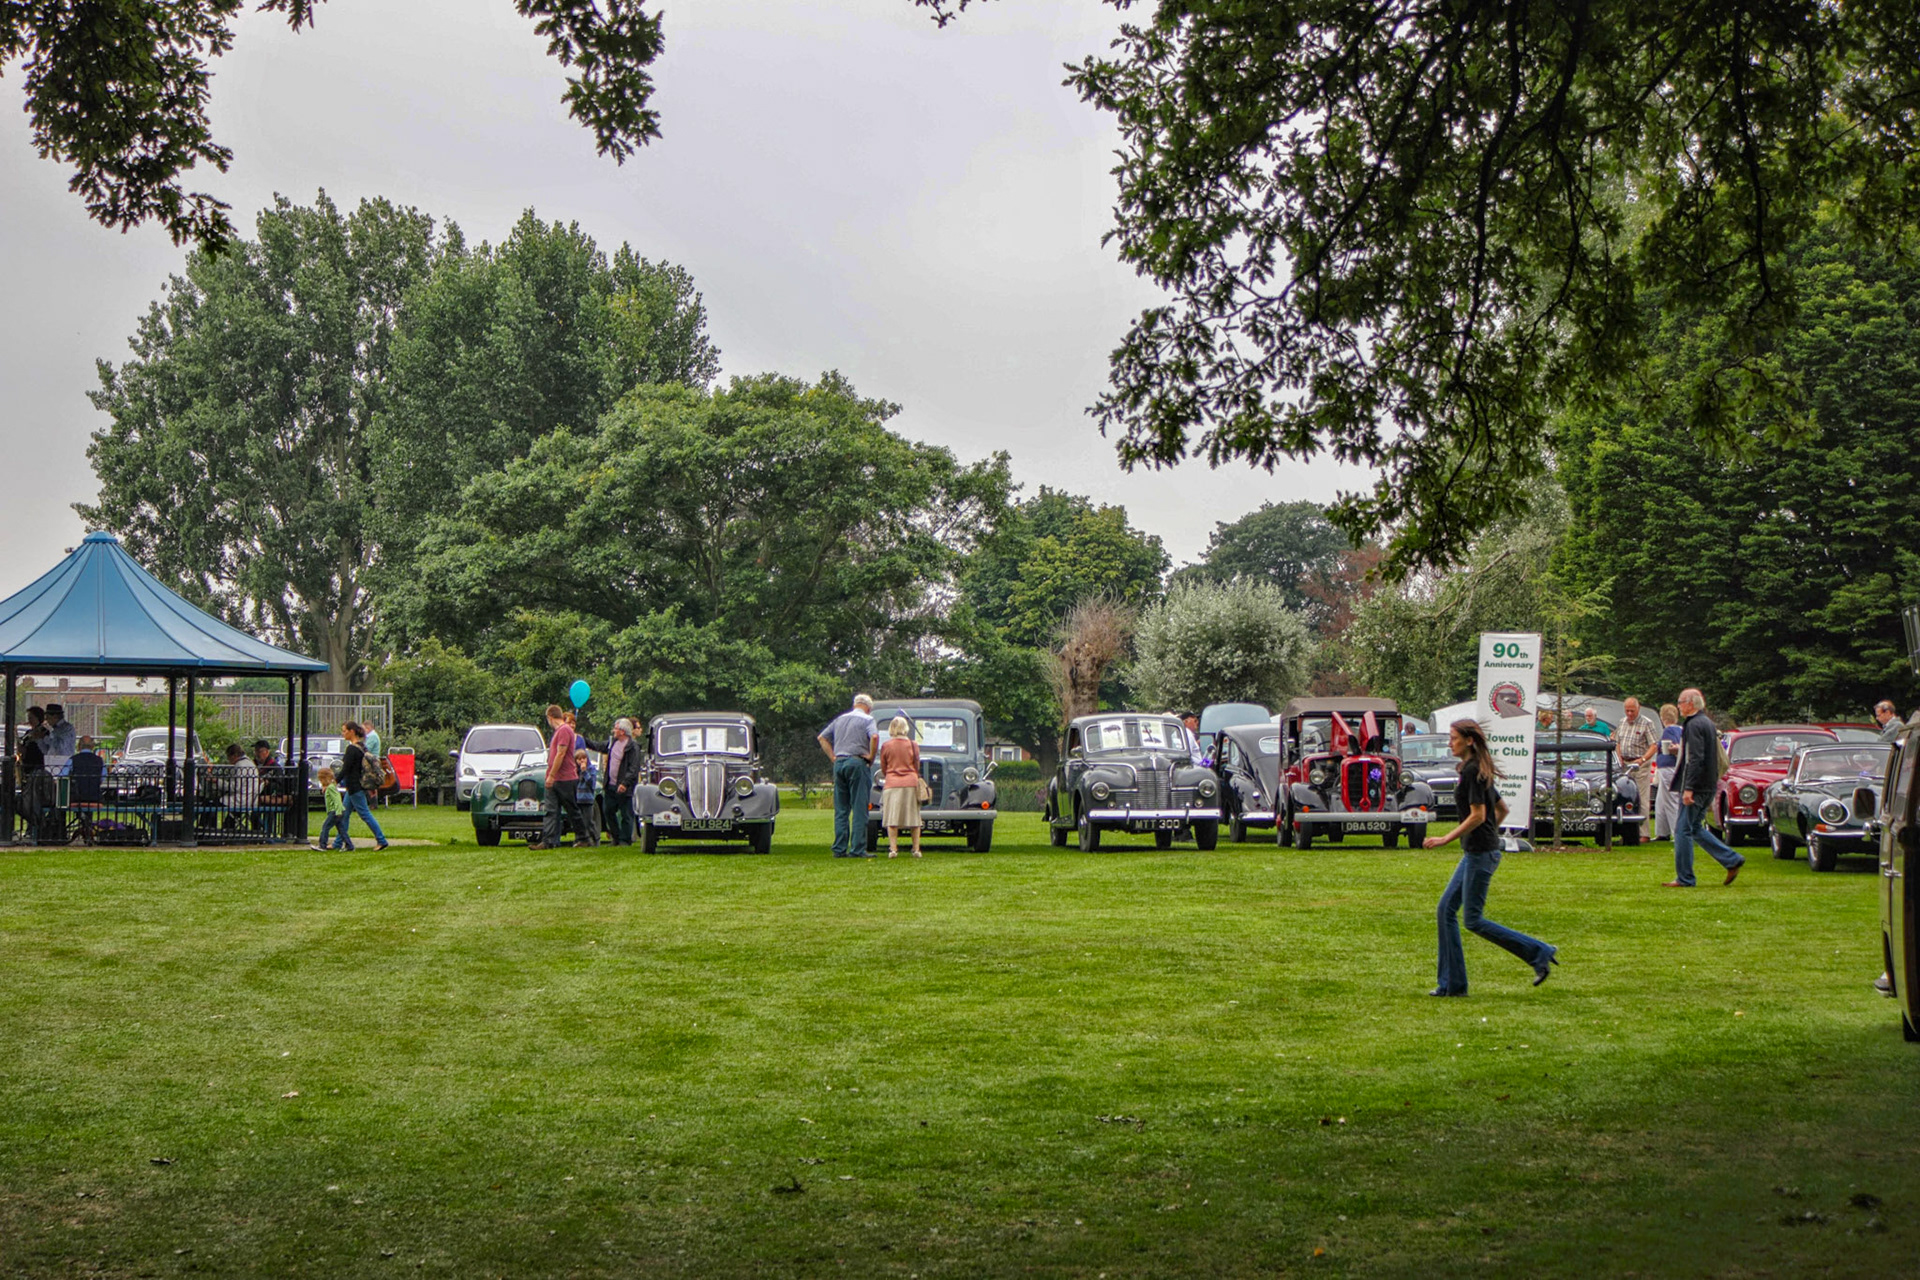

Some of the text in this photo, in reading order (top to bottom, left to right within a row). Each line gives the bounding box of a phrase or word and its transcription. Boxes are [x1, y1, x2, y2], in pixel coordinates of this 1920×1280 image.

[1493, 643, 1528, 658] 90th
[1484, 661, 1534, 669] Anniversary
[1502, 747, 1529, 756] Club
[684, 820, 730, 829] EPU 924
[927, 821, 946, 829] 592
[1135, 820, 1180, 829] MTT 300
[1346, 822, 1386, 831] DBA 520
